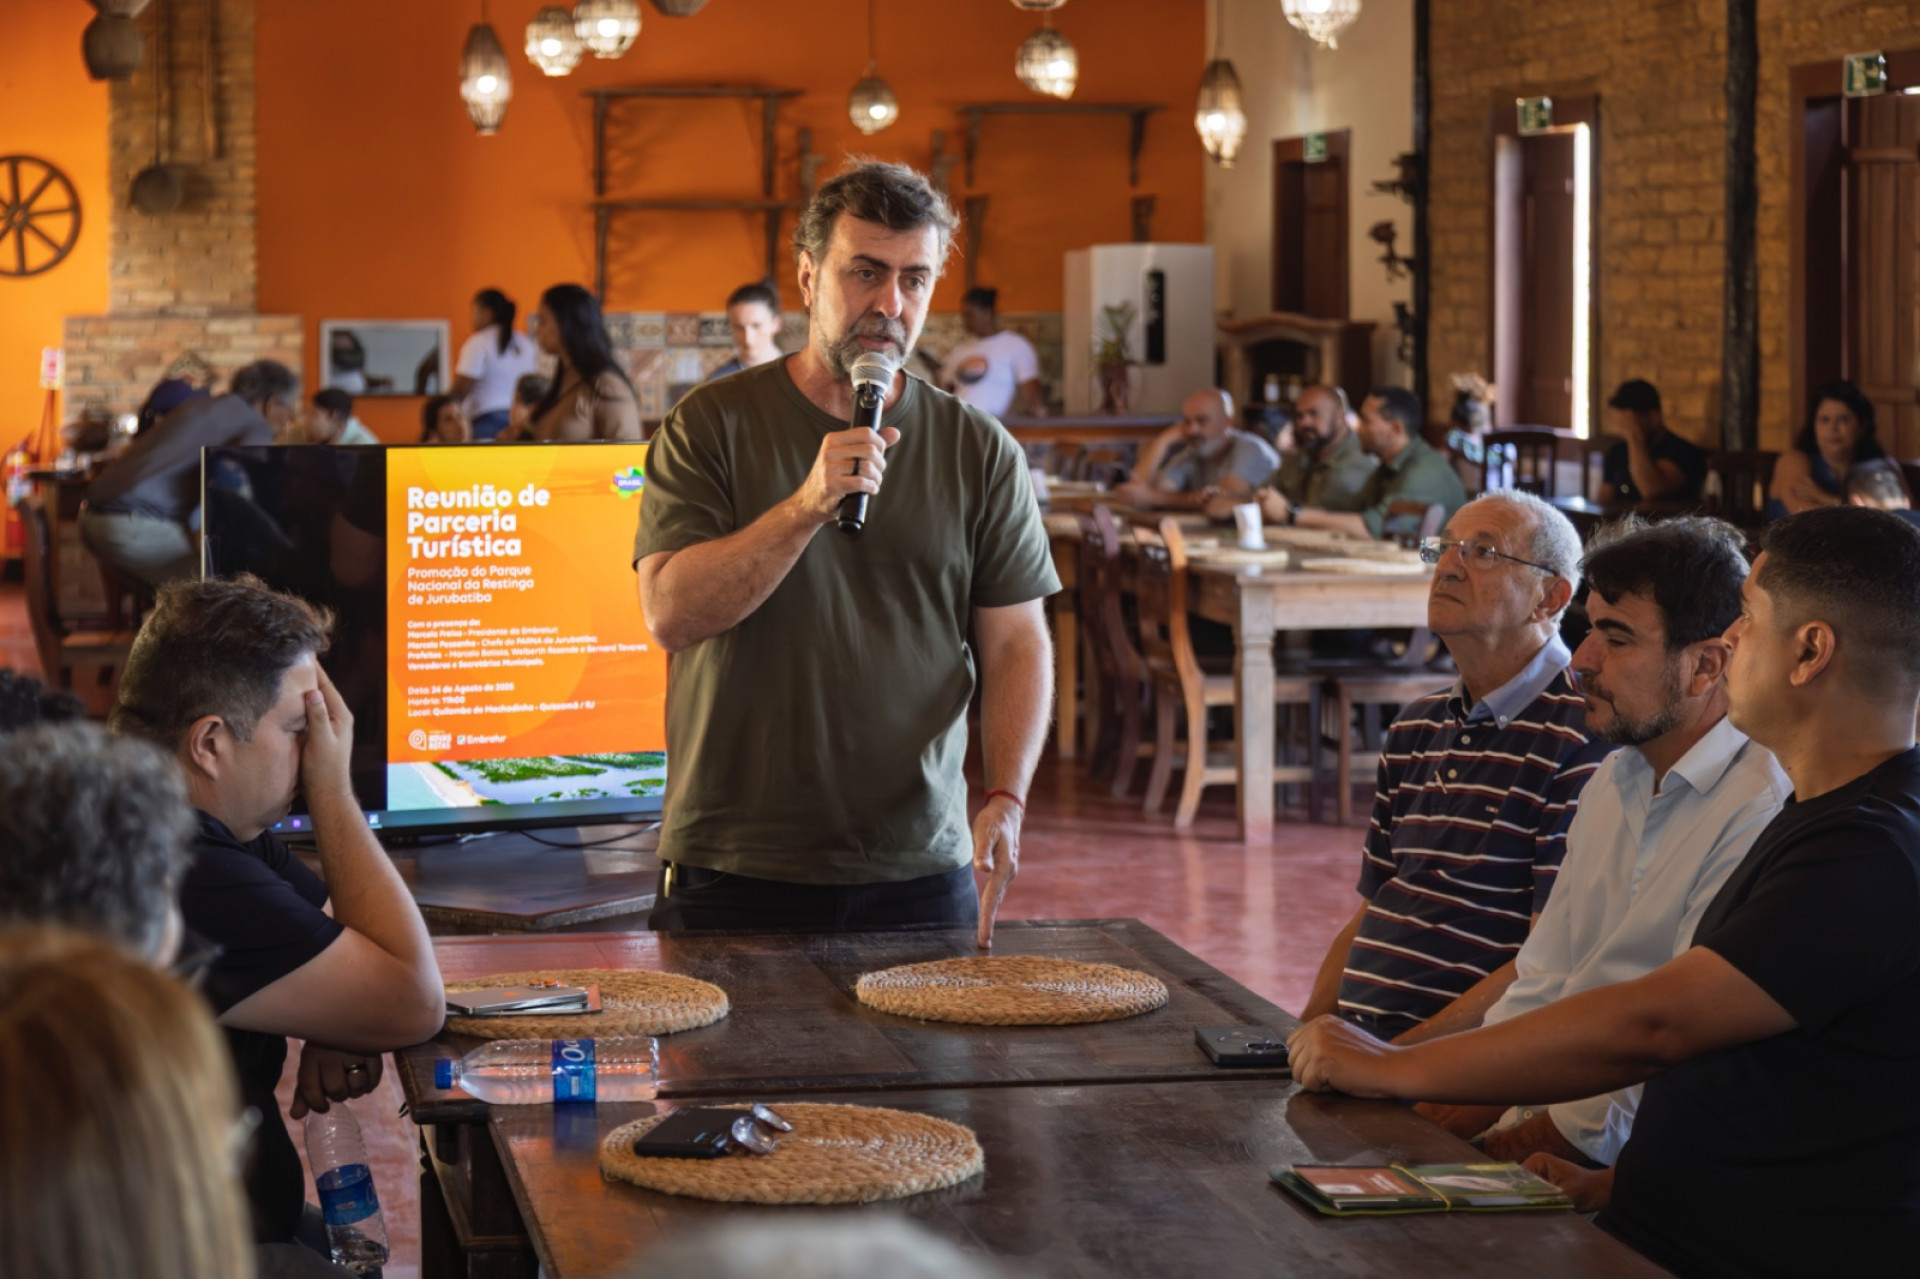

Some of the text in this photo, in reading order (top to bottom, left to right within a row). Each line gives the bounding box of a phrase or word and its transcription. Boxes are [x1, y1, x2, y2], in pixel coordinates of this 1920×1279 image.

[408, 484, 550, 509] Reunião de
[408, 509, 516, 533] Parceria
[407, 533, 521, 558] Turística
[408, 565, 531, 579] Promoção do Parque
[408, 578, 534, 592] Nacional da Restinga
[408, 592, 492, 605] de Jurubatiba
[443, 684, 453, 694] de
[454, 684, 483, 695] Agosto
[483, 683, 494, 692] de
[473, 706, 484, 715] de
